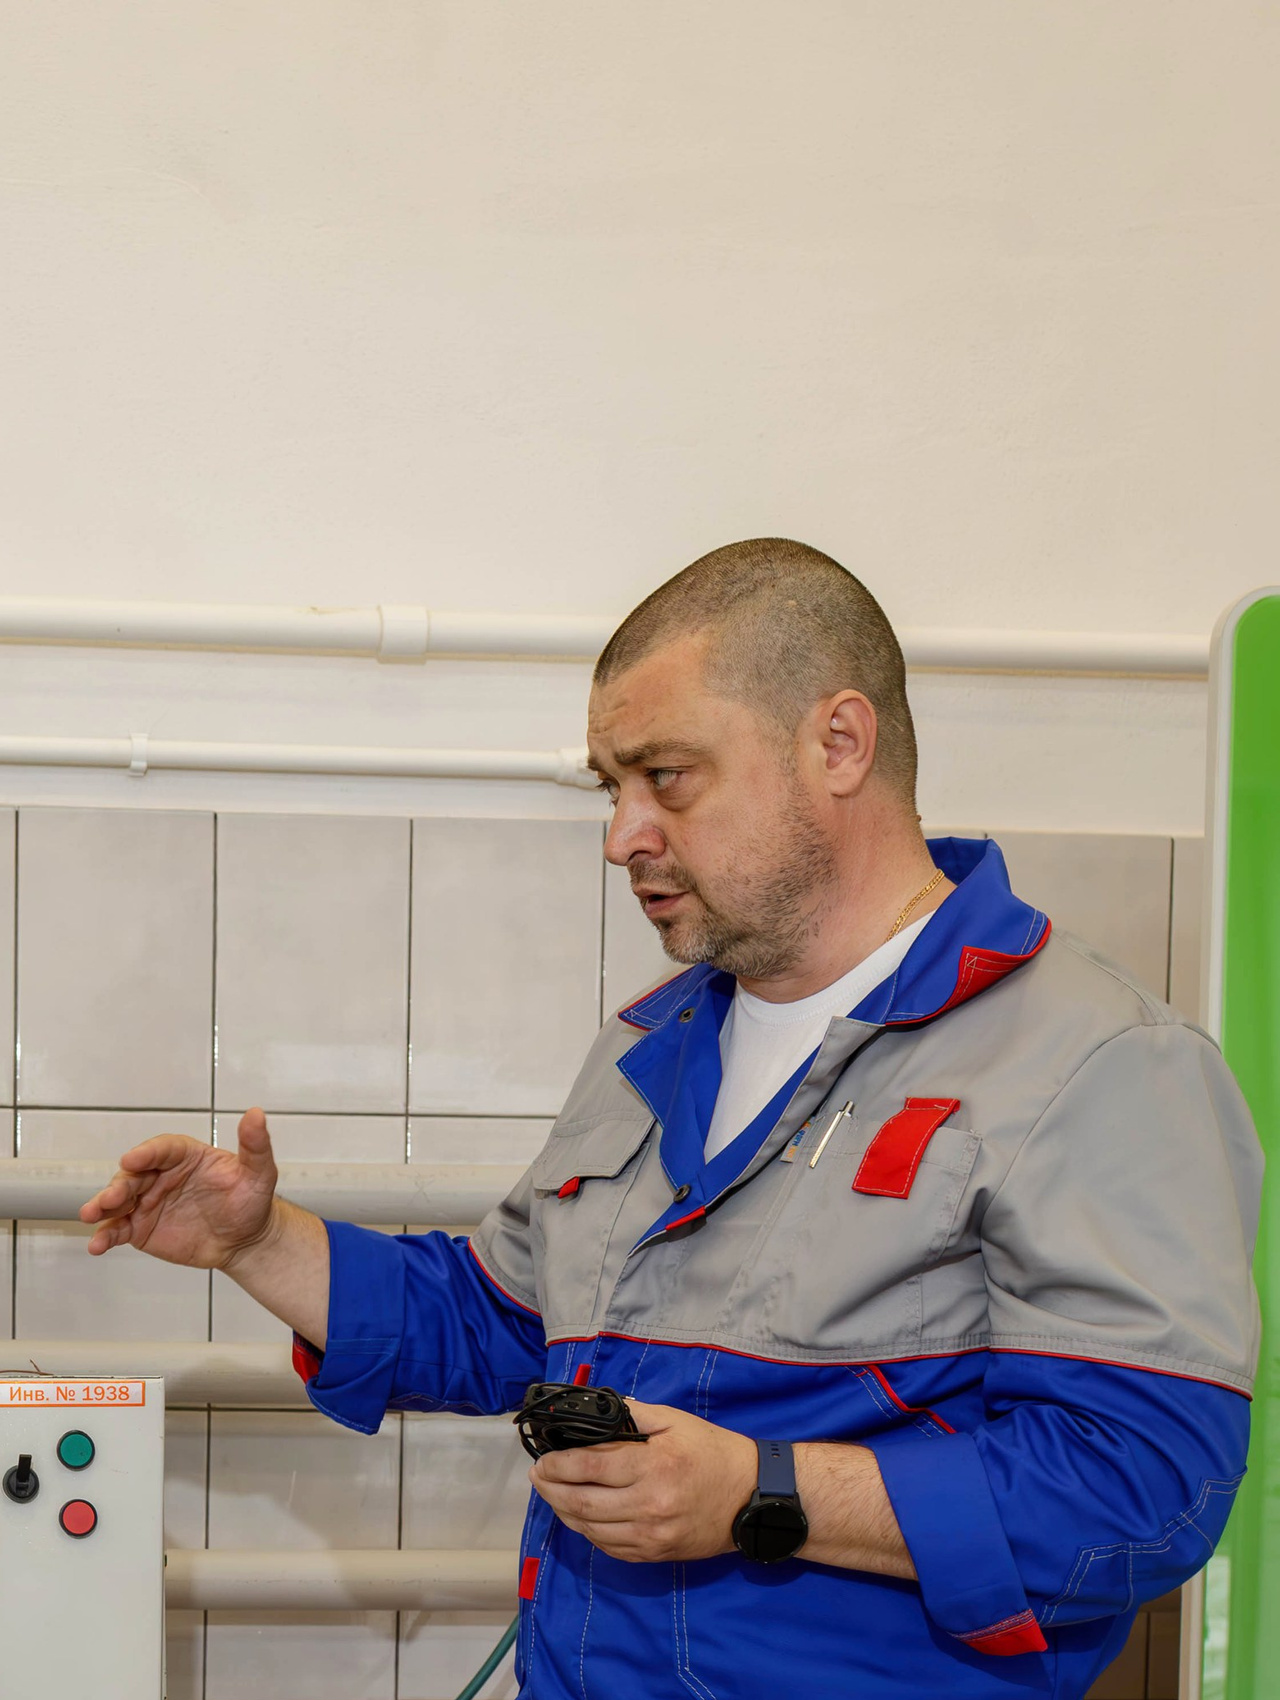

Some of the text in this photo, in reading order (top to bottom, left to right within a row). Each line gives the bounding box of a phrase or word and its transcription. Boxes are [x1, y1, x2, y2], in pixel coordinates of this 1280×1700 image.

[9, 1386, 130, 1402] Инв. № 1938
